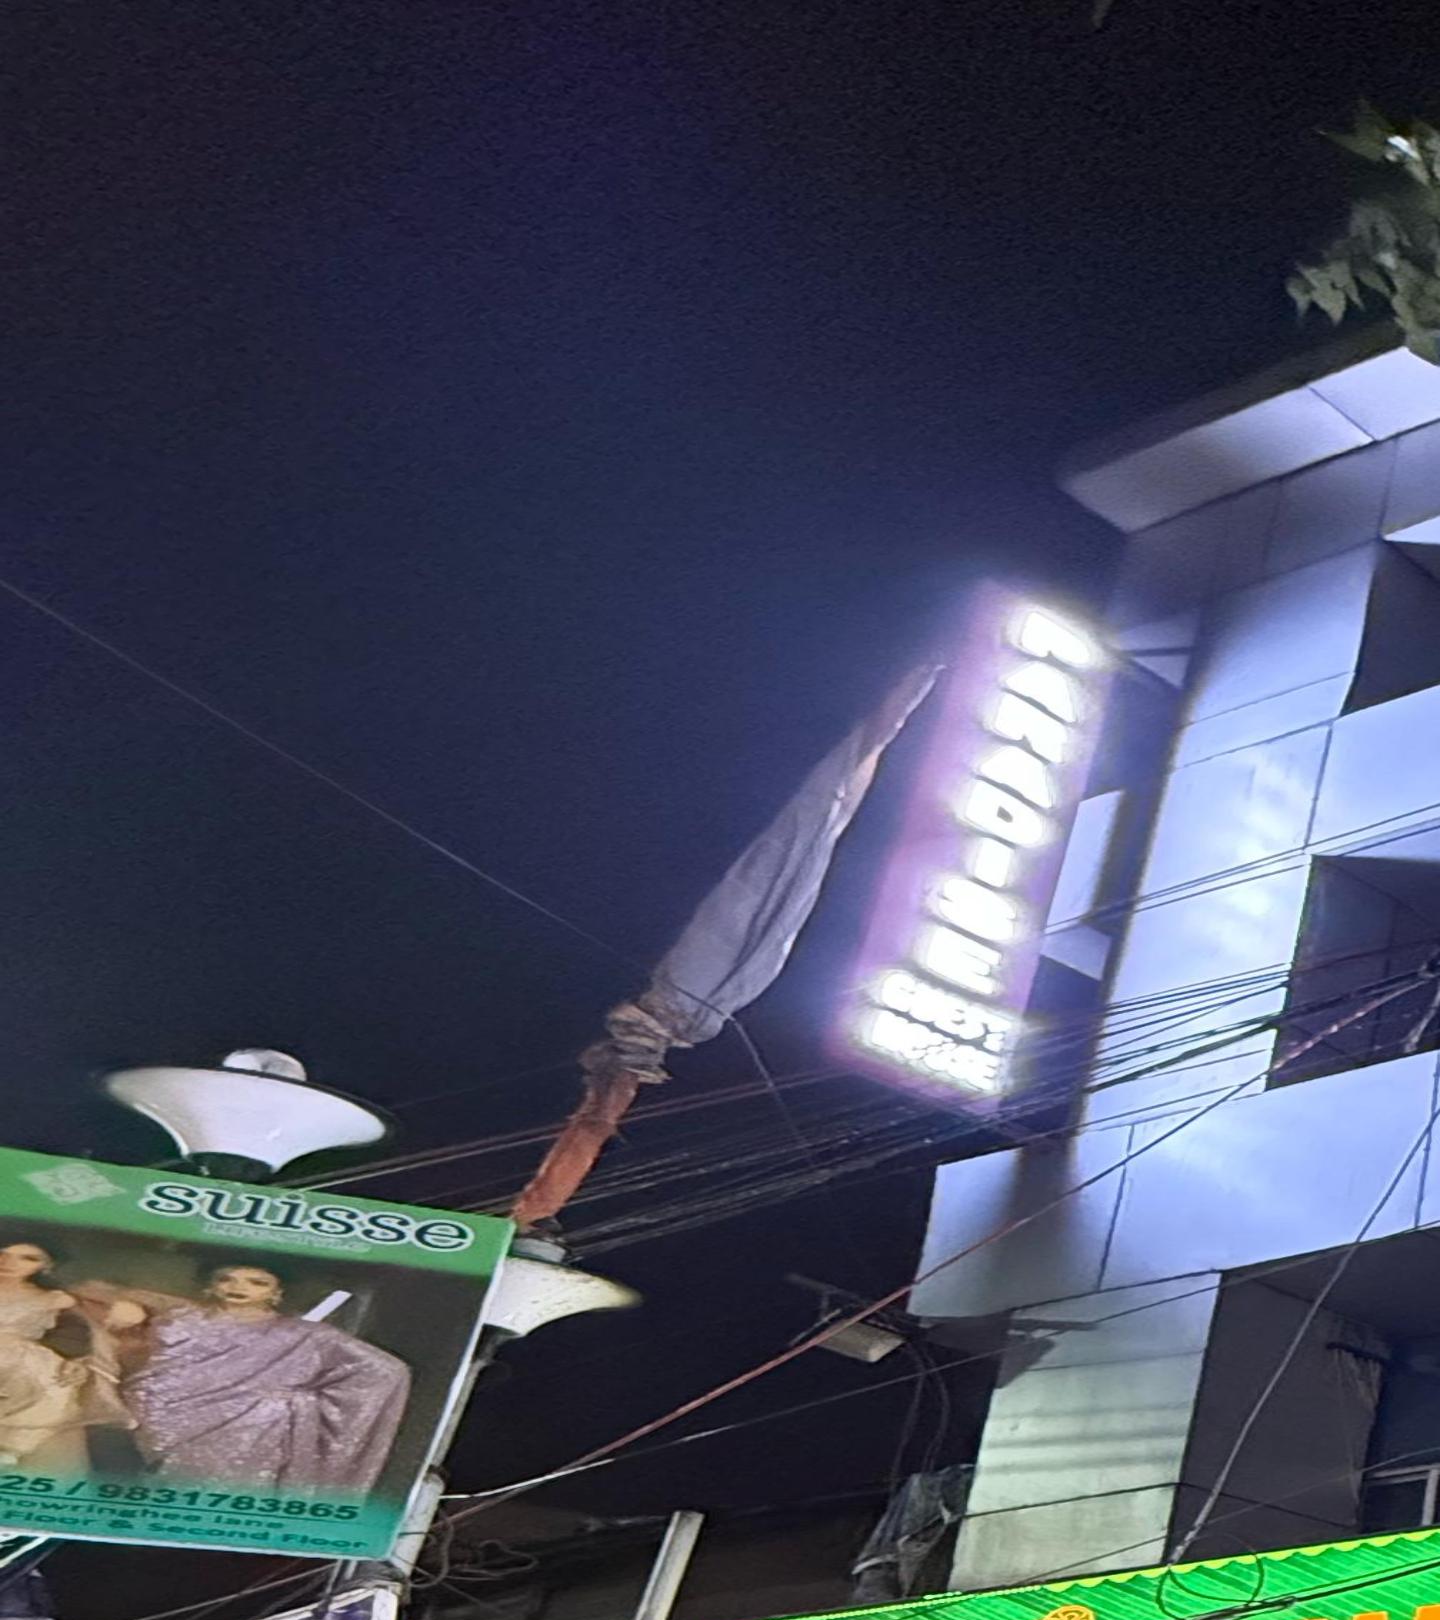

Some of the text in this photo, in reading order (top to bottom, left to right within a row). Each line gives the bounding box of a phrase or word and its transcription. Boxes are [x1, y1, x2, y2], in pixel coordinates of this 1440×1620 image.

[142, 1182, 473, 1252] suisse
[98, 1483, 359, 1520] 9831783865
[149, 1522, 271, 1542] Second
[282, 1533, 368, 1550] Floor
